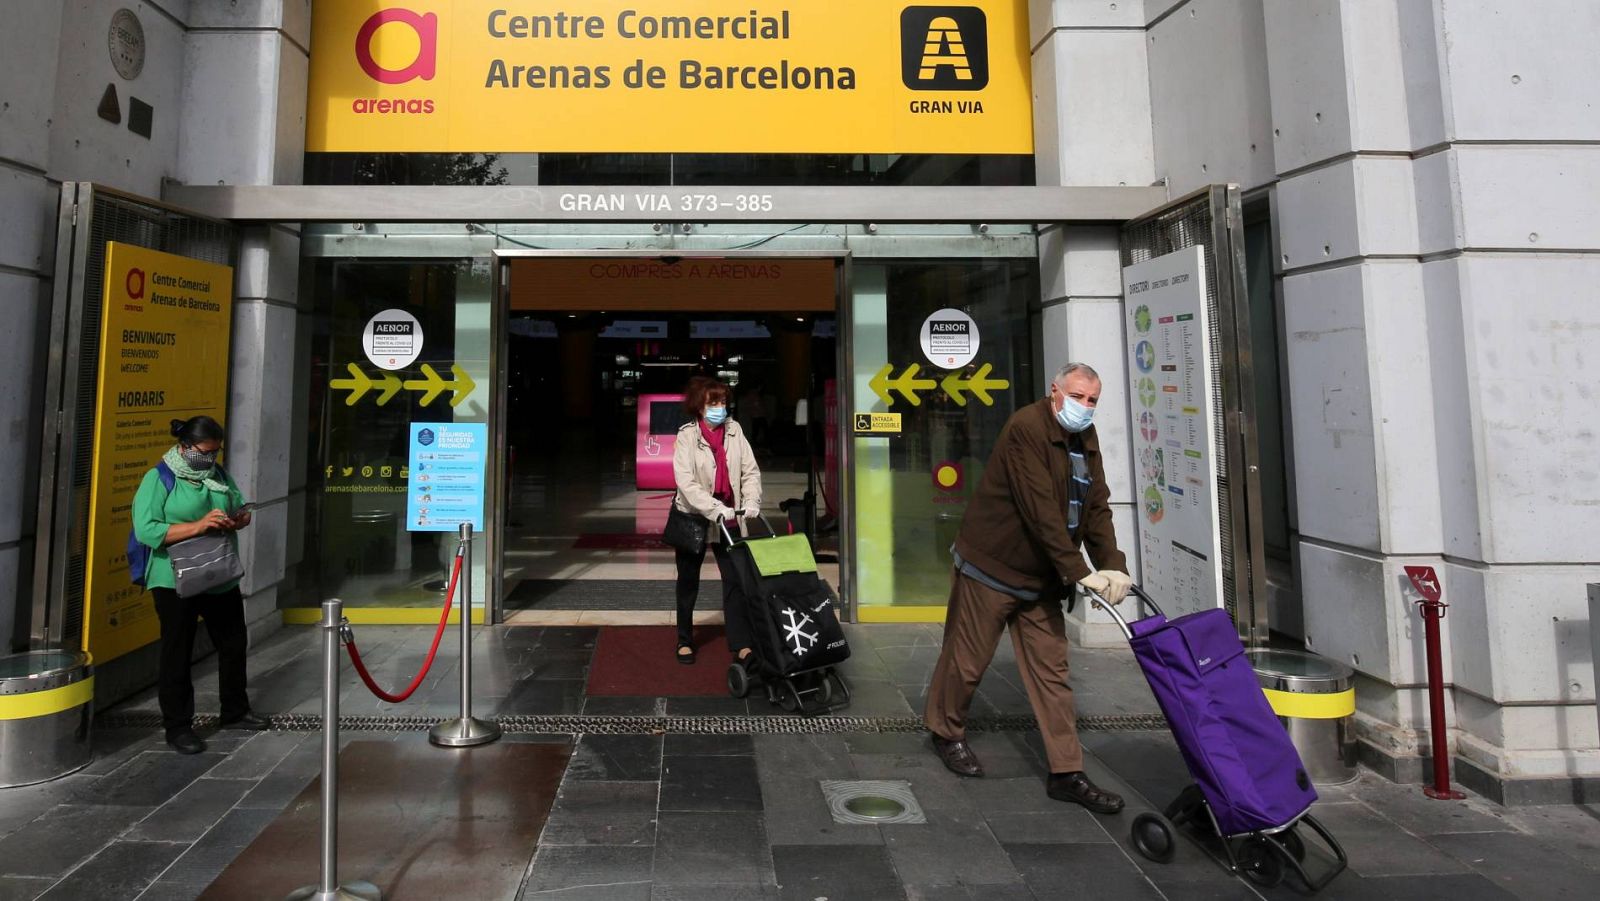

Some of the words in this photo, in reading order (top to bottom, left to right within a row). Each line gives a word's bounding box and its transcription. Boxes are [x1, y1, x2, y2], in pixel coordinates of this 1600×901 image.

[488, 9, 605, 38] Centre
[617, 9, 790, 39] Comercial
[485, 59, 611, 89] Arenas
[623, 59, 666, 89] de
[680, 59, 856, 90] Barcelona
[352, 98, 434, 114] arenas
[909, 101, 952, 114] GRAN
[957, 101, 984, 114] VIA
[560, 194, 625, 211] GRAN
[635, 194, 672, 211] VIA
[590, 263, 682, 279] COMPRES
[689, 264, 702, 279] A
[708, 263, 781, 279] ARENAS
[152, 272, 177, 287] Centre
[178, 276, 210, 292] Comercial
[150, 292, 177, 306] Arenas
[178, 296, 187, 307] de
[188, 297, 220, 312] Barcelona
[376, 324, 410, 332] AENOR
[932, 323, 966, 332] AENOR
[122, 329, 176, 346] BENVINGUTS
[121, 348, 159, 360] BIENVENIDOS
[120, 363, 149, 373] WELCOME
[118, 391, 165, 407] HORARIS
